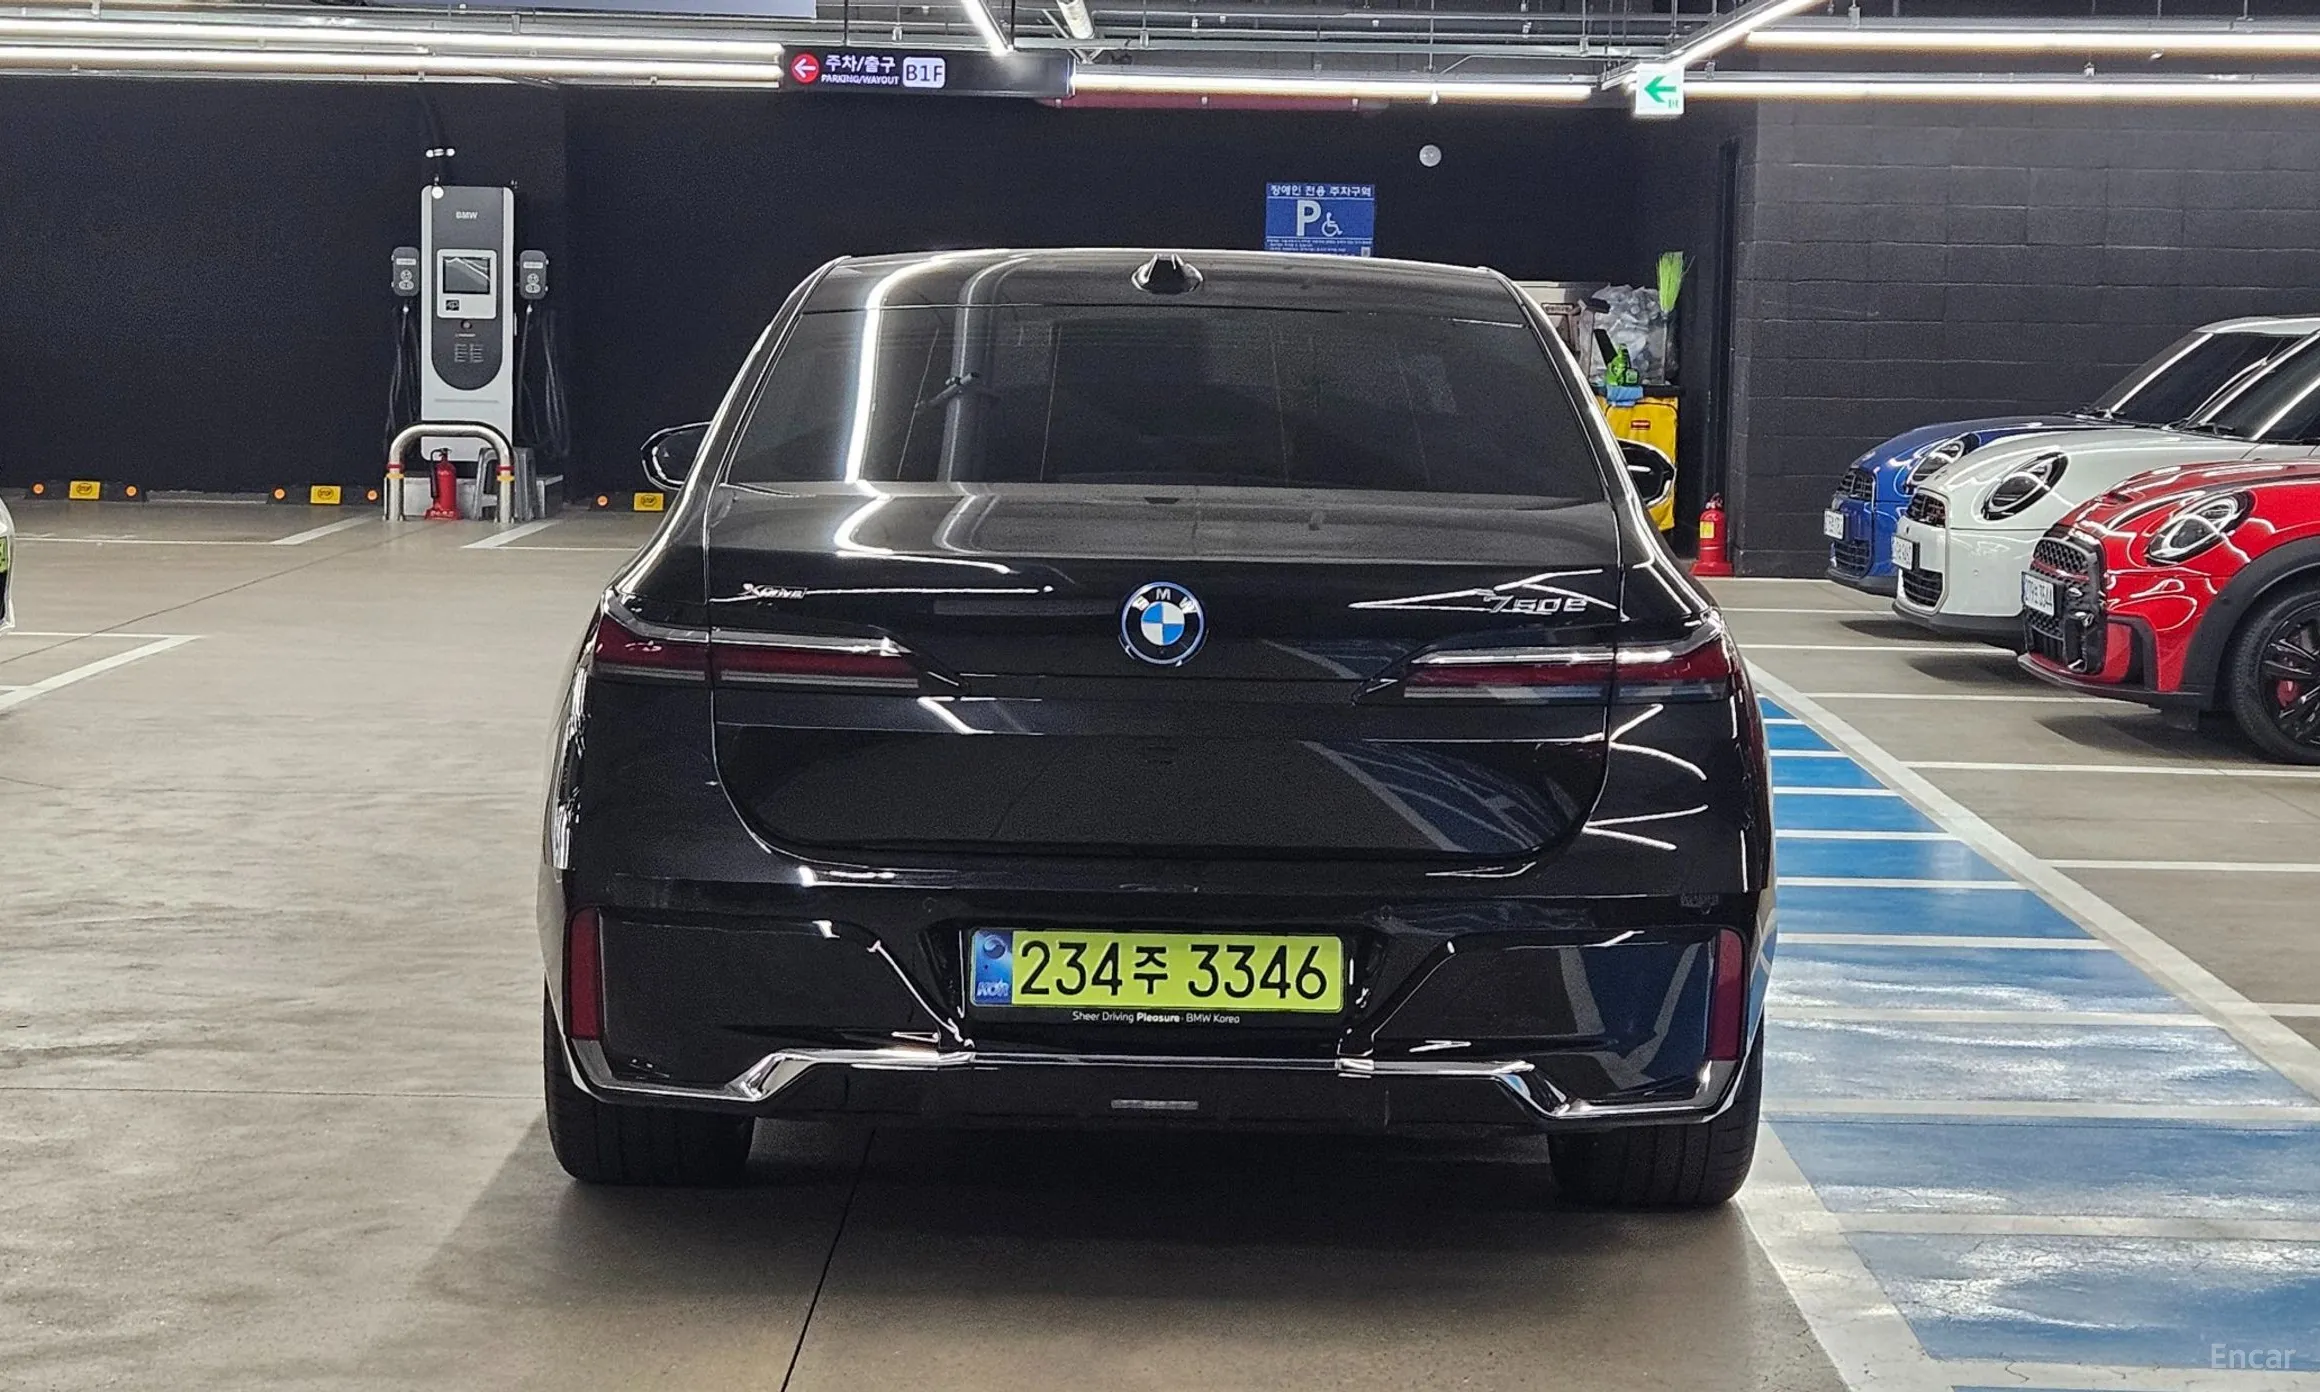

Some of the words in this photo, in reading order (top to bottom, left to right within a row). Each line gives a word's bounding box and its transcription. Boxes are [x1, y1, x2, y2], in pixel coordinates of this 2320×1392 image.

[825, 54, 896, 74] 주차/출구
[905, 64, 944, 83] B1F
[821, 74, 900, 86] PARKING/WAYOUT
[1270, 185, 1301, 197] 장애인
[1305, 185, 1326, 197] 전용
[1329, 186, 1372, 197] 주차구역
[1296, 199, 1322, 237] P
[1132, 588, 1199, 615] BMW
[1020, 940, 1170, 996] 234주
[1187, 943, 1328, 1000] 3346
[1072, 1010, 1100, 1022] Sheer
[1102, 1011, 1134, 1024] Driving
[1136, 1011, 1180, 1023] Pleasure
[1186, 1013, 1211, 1023] BMW
[1213, 1013, 1240, 1024] Korea
